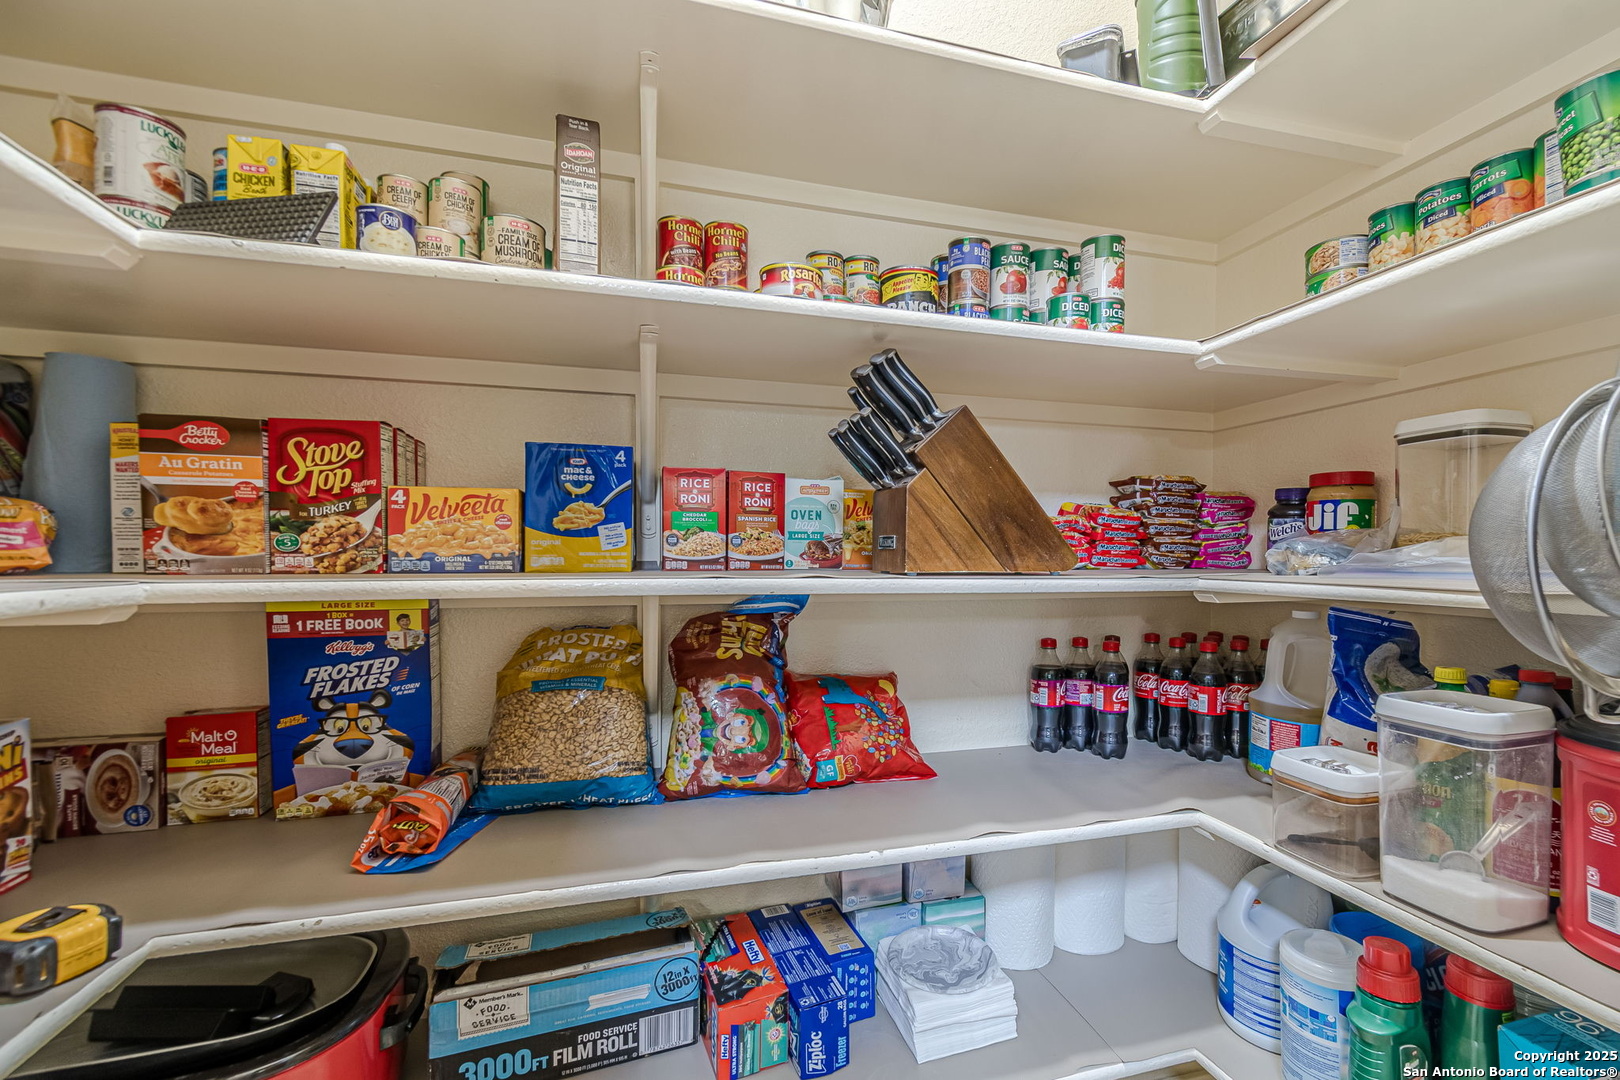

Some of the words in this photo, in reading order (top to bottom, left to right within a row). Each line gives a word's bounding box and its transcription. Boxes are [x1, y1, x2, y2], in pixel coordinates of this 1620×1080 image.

[565, 148, 594, 158] IDAHOAN
[560, 161, 597, 175] Original
[232, 172, 275, 187] CHICKEN
[560, 177, 583, 188] Nutrition
[583, 180, 597, 191] Facts
[1470, 169, 1507, 195] Carrots
[387, 185, 412, 196] CREAM
[413, 189, 422, 199] OF
[444, 191, 467, 204] CREAM
[469, 198, 475, 207] OF
[391, 193, 417, 206] CELERY
[446, 200, 474, 213] CHICKEN
[1418, 190, 1462, 217] Potatoes
[1427, 208, 1449, 223] Diced
[501, 227, 525, 237] FAMILY
[674, 231, 701, 246] Chili
[707, 226, 745, 240] Hormel
[418, 241, 441, 252] CREAM
[444, 245, 452, 254] OF
[497, 233, 530, 248] CREAM
[531, 241, 541, 252] OF
[712, 235, 740, 248] Chili
[495, 245, 543, 265] MUSHROOM
[724, 250, 739, 258] Beans
[1001, 255, 1029, 266] SAUCE
[1061, 301, 1090, 312] DICED
[184, 424, 219, 438] Betty
[179, 433, 226, 446] Crocker
[158, 455, 183, 468] Au
[185, 457, 243, 470] Gratin
[276, 437, 364, 485] Stove
[615, 450, 627, 463] 4
[585, 466, 593, 474] &
[306, 466, 352, 498] Top
[680, 478, 710, 488] RICE
[744, 482, 771, 492] RICE
[390, 489, 407, 505] 4
[680, 494, 710, 504] RONI
[744, 497, 771, 507] RONI
[308, 501, 352, 517] TURKEY
[410, 493, 505, 524] Velveeta
[790, 509, 822, 520] OVEN
[1308, 502, 1359, 531] Jif
[795, 519, 820, 530] bags
[1269, 522, 1303, 538] Welch's
[530, 538, 562, 546] original
[296, 620, 303, 632] 1
[306, 618, 342, 632] FREE
[345, 617, 384, 631] BOOK
[325, 640, 375, 656] Kellogg's
[537, 632, 628, 650] FROSTED
[303, 656, 400, 684] FROSTED
[309, 672, 392, 699] FLAKES
[391, 684, 401, 692] OF
[401, 682, 421, 690] CORN
[190, 730, 223, 744] Malt
[225, 730, 237, 741] O
[201, 742, 238, 755] Meal
[195, 755, 227, 765] original
[826, 764, 835, 777] GF
[744, 940, 761, 964] Hefty
[478, 994, 506, 1004] Member's
[837, 1000, 843, 1010] 28
[480, 1003, 507, 1016] FOOD
[471, 1013, 517, 1029] SERVICE
[1554, 1009, 1606, 1036] 96
[577, 1030, 600, 1043] FOOD
[603, 1022, 638, 1038] SERVICE
[552, 1042, 593, 1067] FILM
[596, 1032, 638, 1057] ROLL
[808, 1031, 826, 1072] Ziploc
[835, 1035, 847, 1068] Freezer
